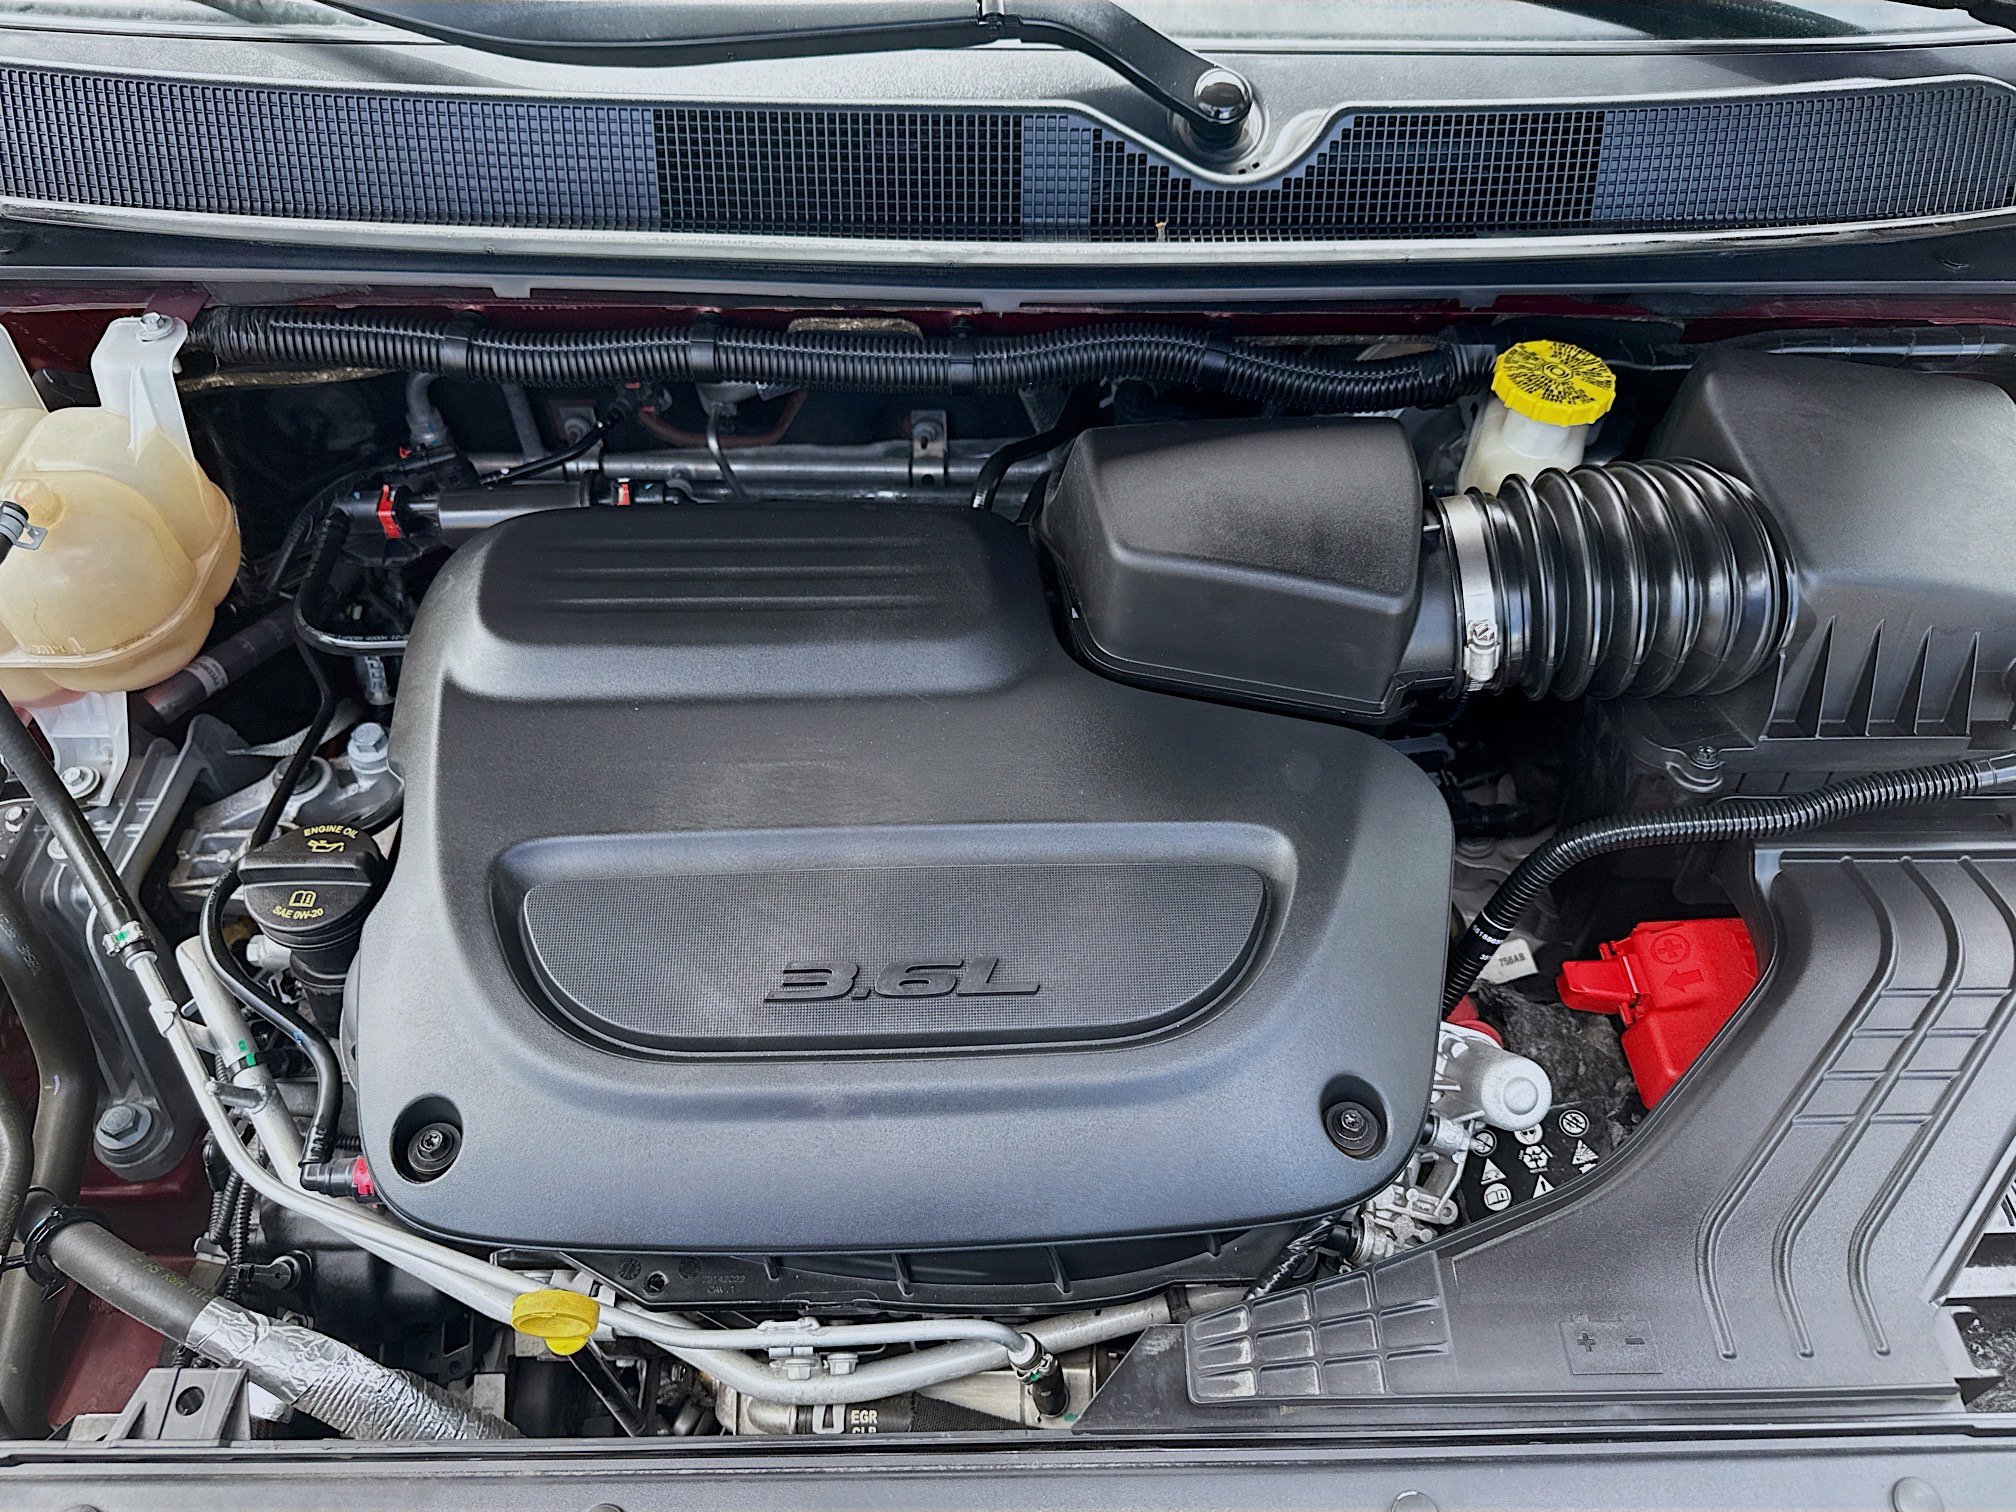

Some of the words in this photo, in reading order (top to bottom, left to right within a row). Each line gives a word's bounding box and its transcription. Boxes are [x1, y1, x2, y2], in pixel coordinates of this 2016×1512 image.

[303, 825, 344, 837] ENGINE
[343, 827, 359, 839] OIL
[272, 905, 292, 919] SAE
[293, 907, 324, 920] 0W-20
[764, 957, 1040, 1003] 3.6L
[851, 1409, 878, 1425] EGR
